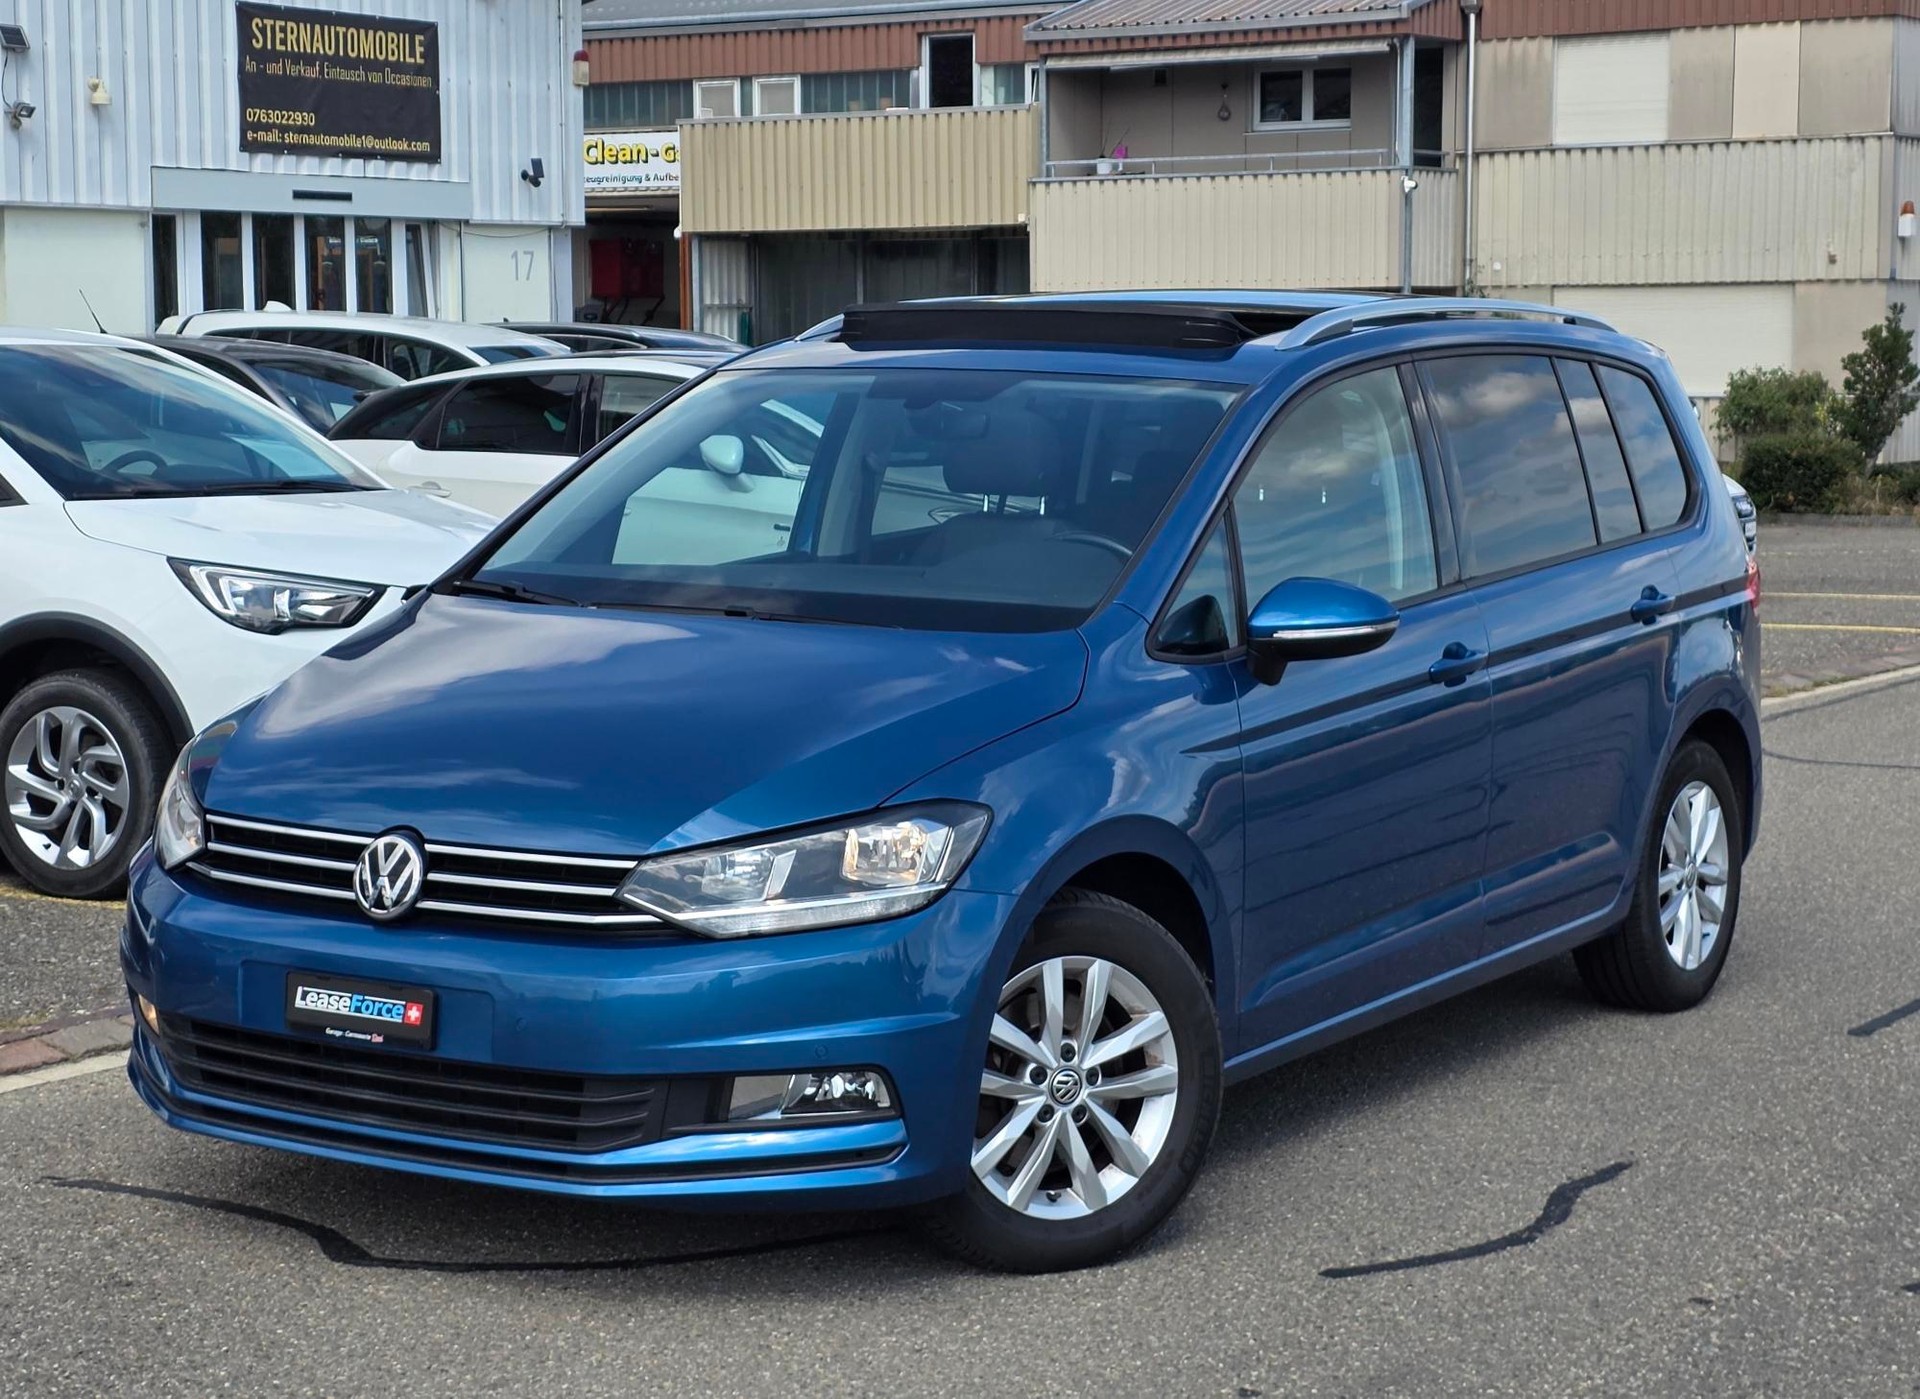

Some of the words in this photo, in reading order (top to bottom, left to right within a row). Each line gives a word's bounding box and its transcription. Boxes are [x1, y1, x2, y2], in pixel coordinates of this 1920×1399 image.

[251, 17, 425, 64] STERNAUTOMOBILE
[245, 55, 257, 73] An
[266, 58, 283, 75] und
[324, 61, 366, 82] Eintausch
[367, 71, 383, 84] von
[385, 67, 432, 88] Occasionen
[246, 107, 316, 127] 0763022930
[247, 128, 282, 143] e-mail:
[284, 131, 430, 152] sternautomobile1@outlook.com
[645, 174, 651, 182] &
[510, 250, 535, 282] 17
[354, 835, 422, 917] VW
[294, 985, 405, 1020] LeaseForce
